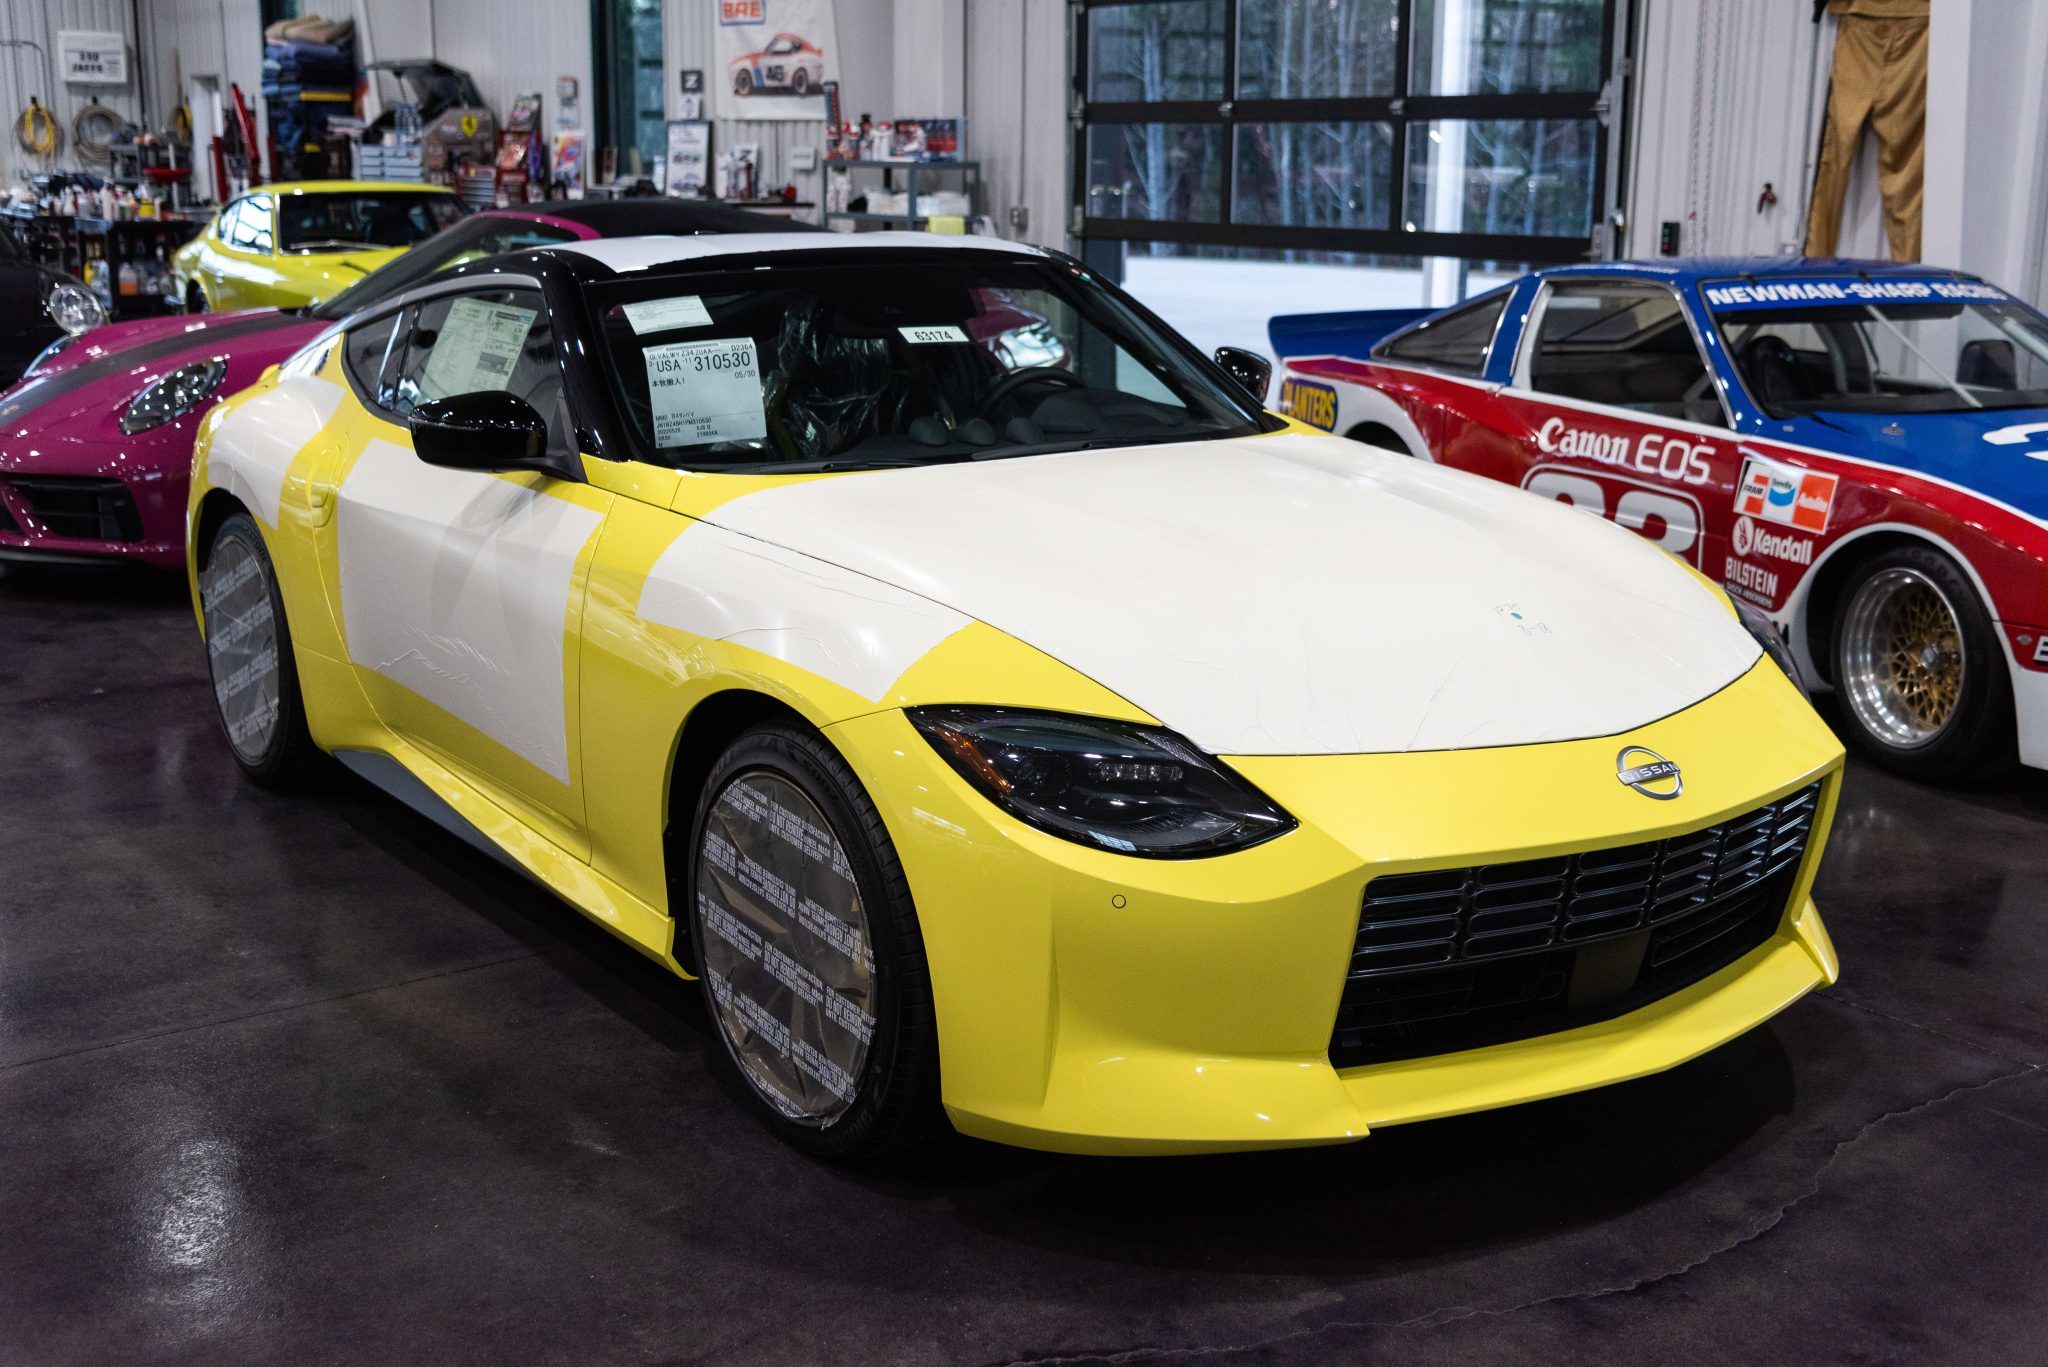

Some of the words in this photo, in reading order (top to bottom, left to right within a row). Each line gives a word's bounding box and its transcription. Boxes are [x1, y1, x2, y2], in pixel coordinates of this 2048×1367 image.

[915, 331, 953, 341] 63174
[656, 359, 681, 372] USA
[694, 351, 750, 371] 310530
[734, 370, 755, 378] 05/30
[1538, 417, 1630, 465] Canon
[1635, 433, 1716, 485] EOS
[1752, 528, 1813, 565] Kendall
[1725, 557, 1778, 597] BILSTEIN
[1621, 763, 1679, 781] NISSAN
